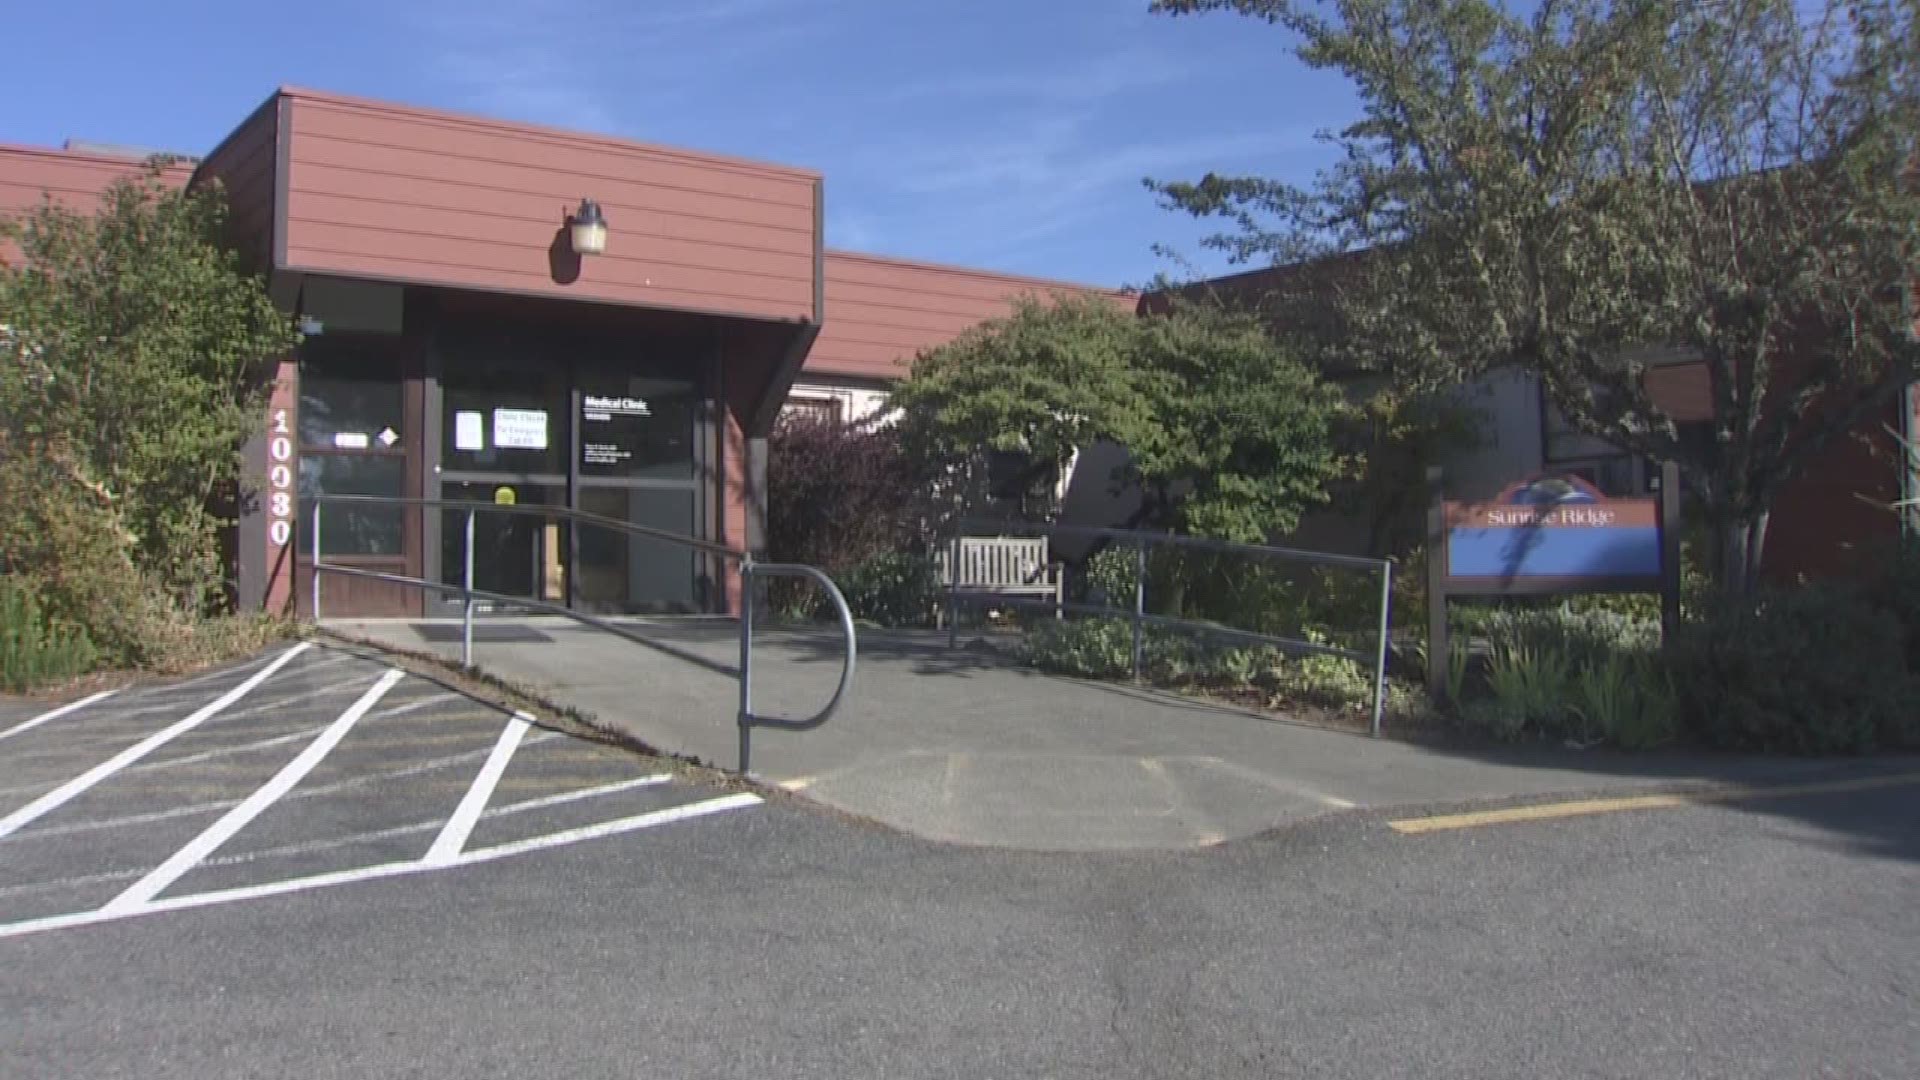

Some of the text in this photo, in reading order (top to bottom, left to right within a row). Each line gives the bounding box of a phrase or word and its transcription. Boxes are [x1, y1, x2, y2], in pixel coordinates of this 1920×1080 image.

[584, 396, 647, 412] Medical Clinic
[1560, 508, 1614, 529] Ridge
